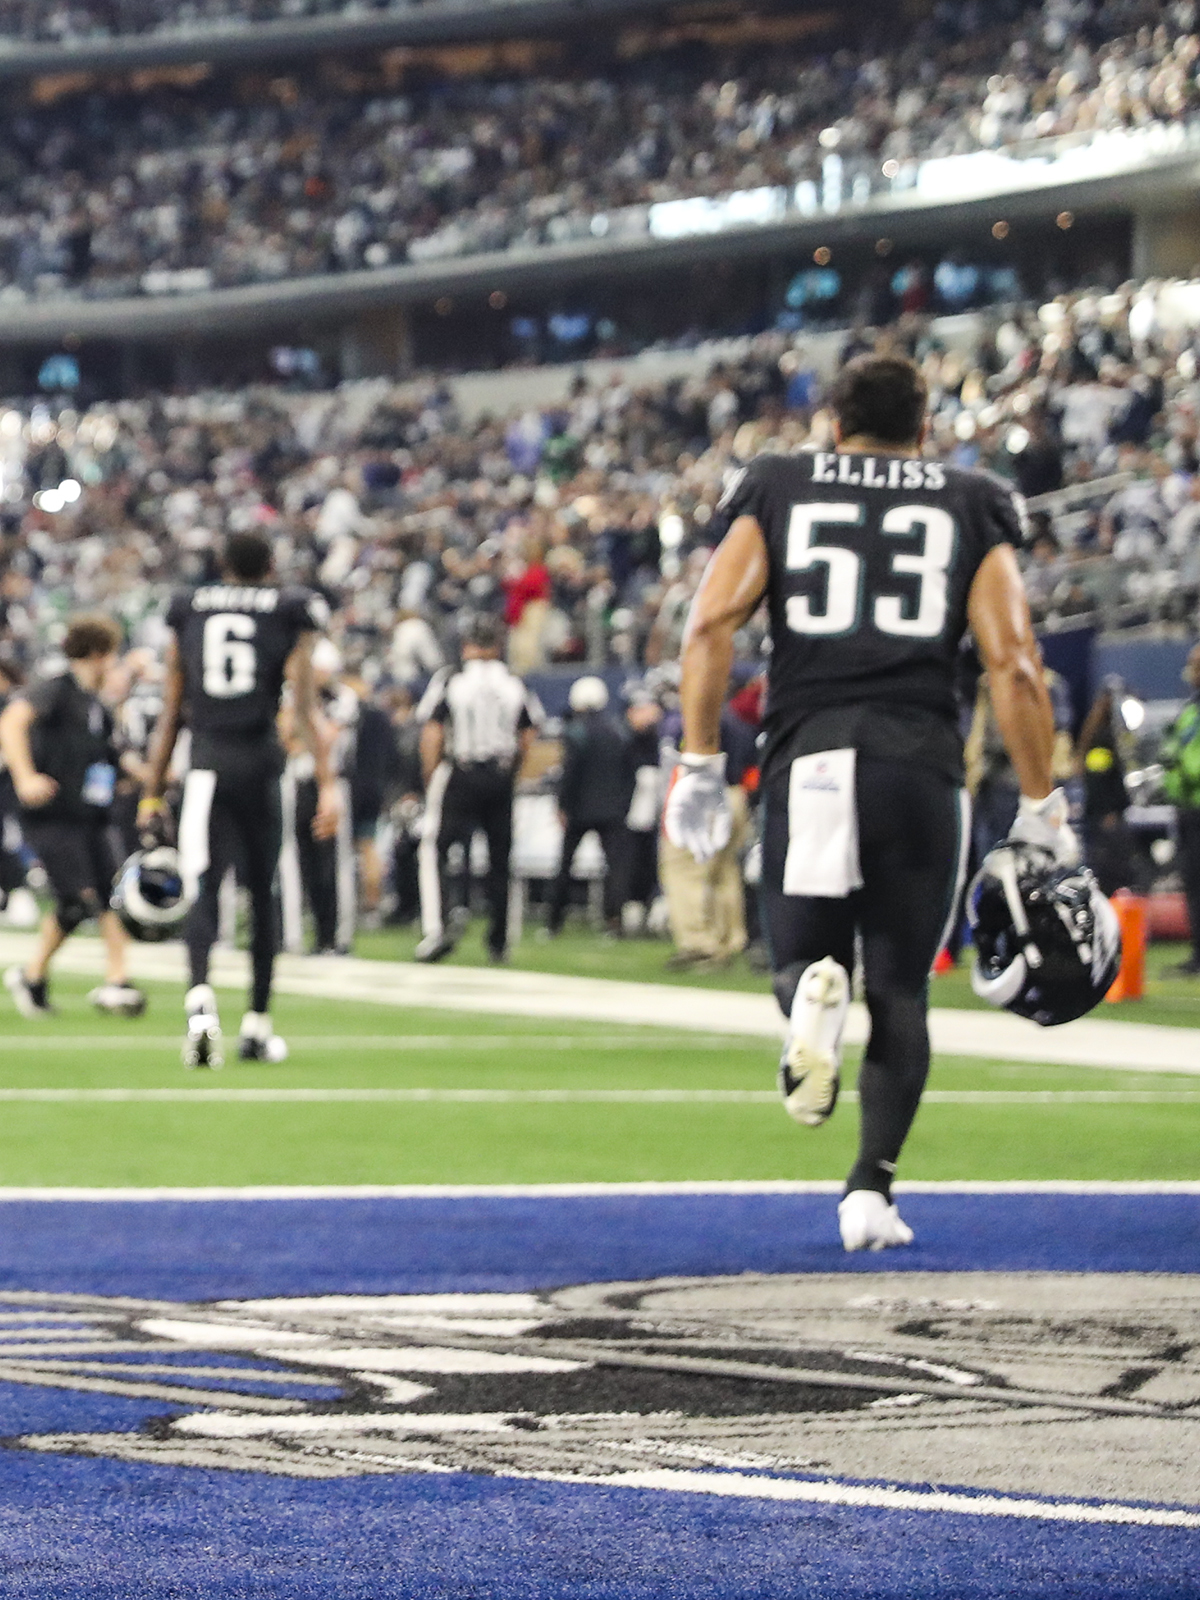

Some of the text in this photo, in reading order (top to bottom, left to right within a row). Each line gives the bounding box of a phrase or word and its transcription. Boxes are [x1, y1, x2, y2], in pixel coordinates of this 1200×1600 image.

[811, 452, 947, 491] ELLISS
[786, 502, 955, 638] 53
[202, 612, 257, 699] 6
